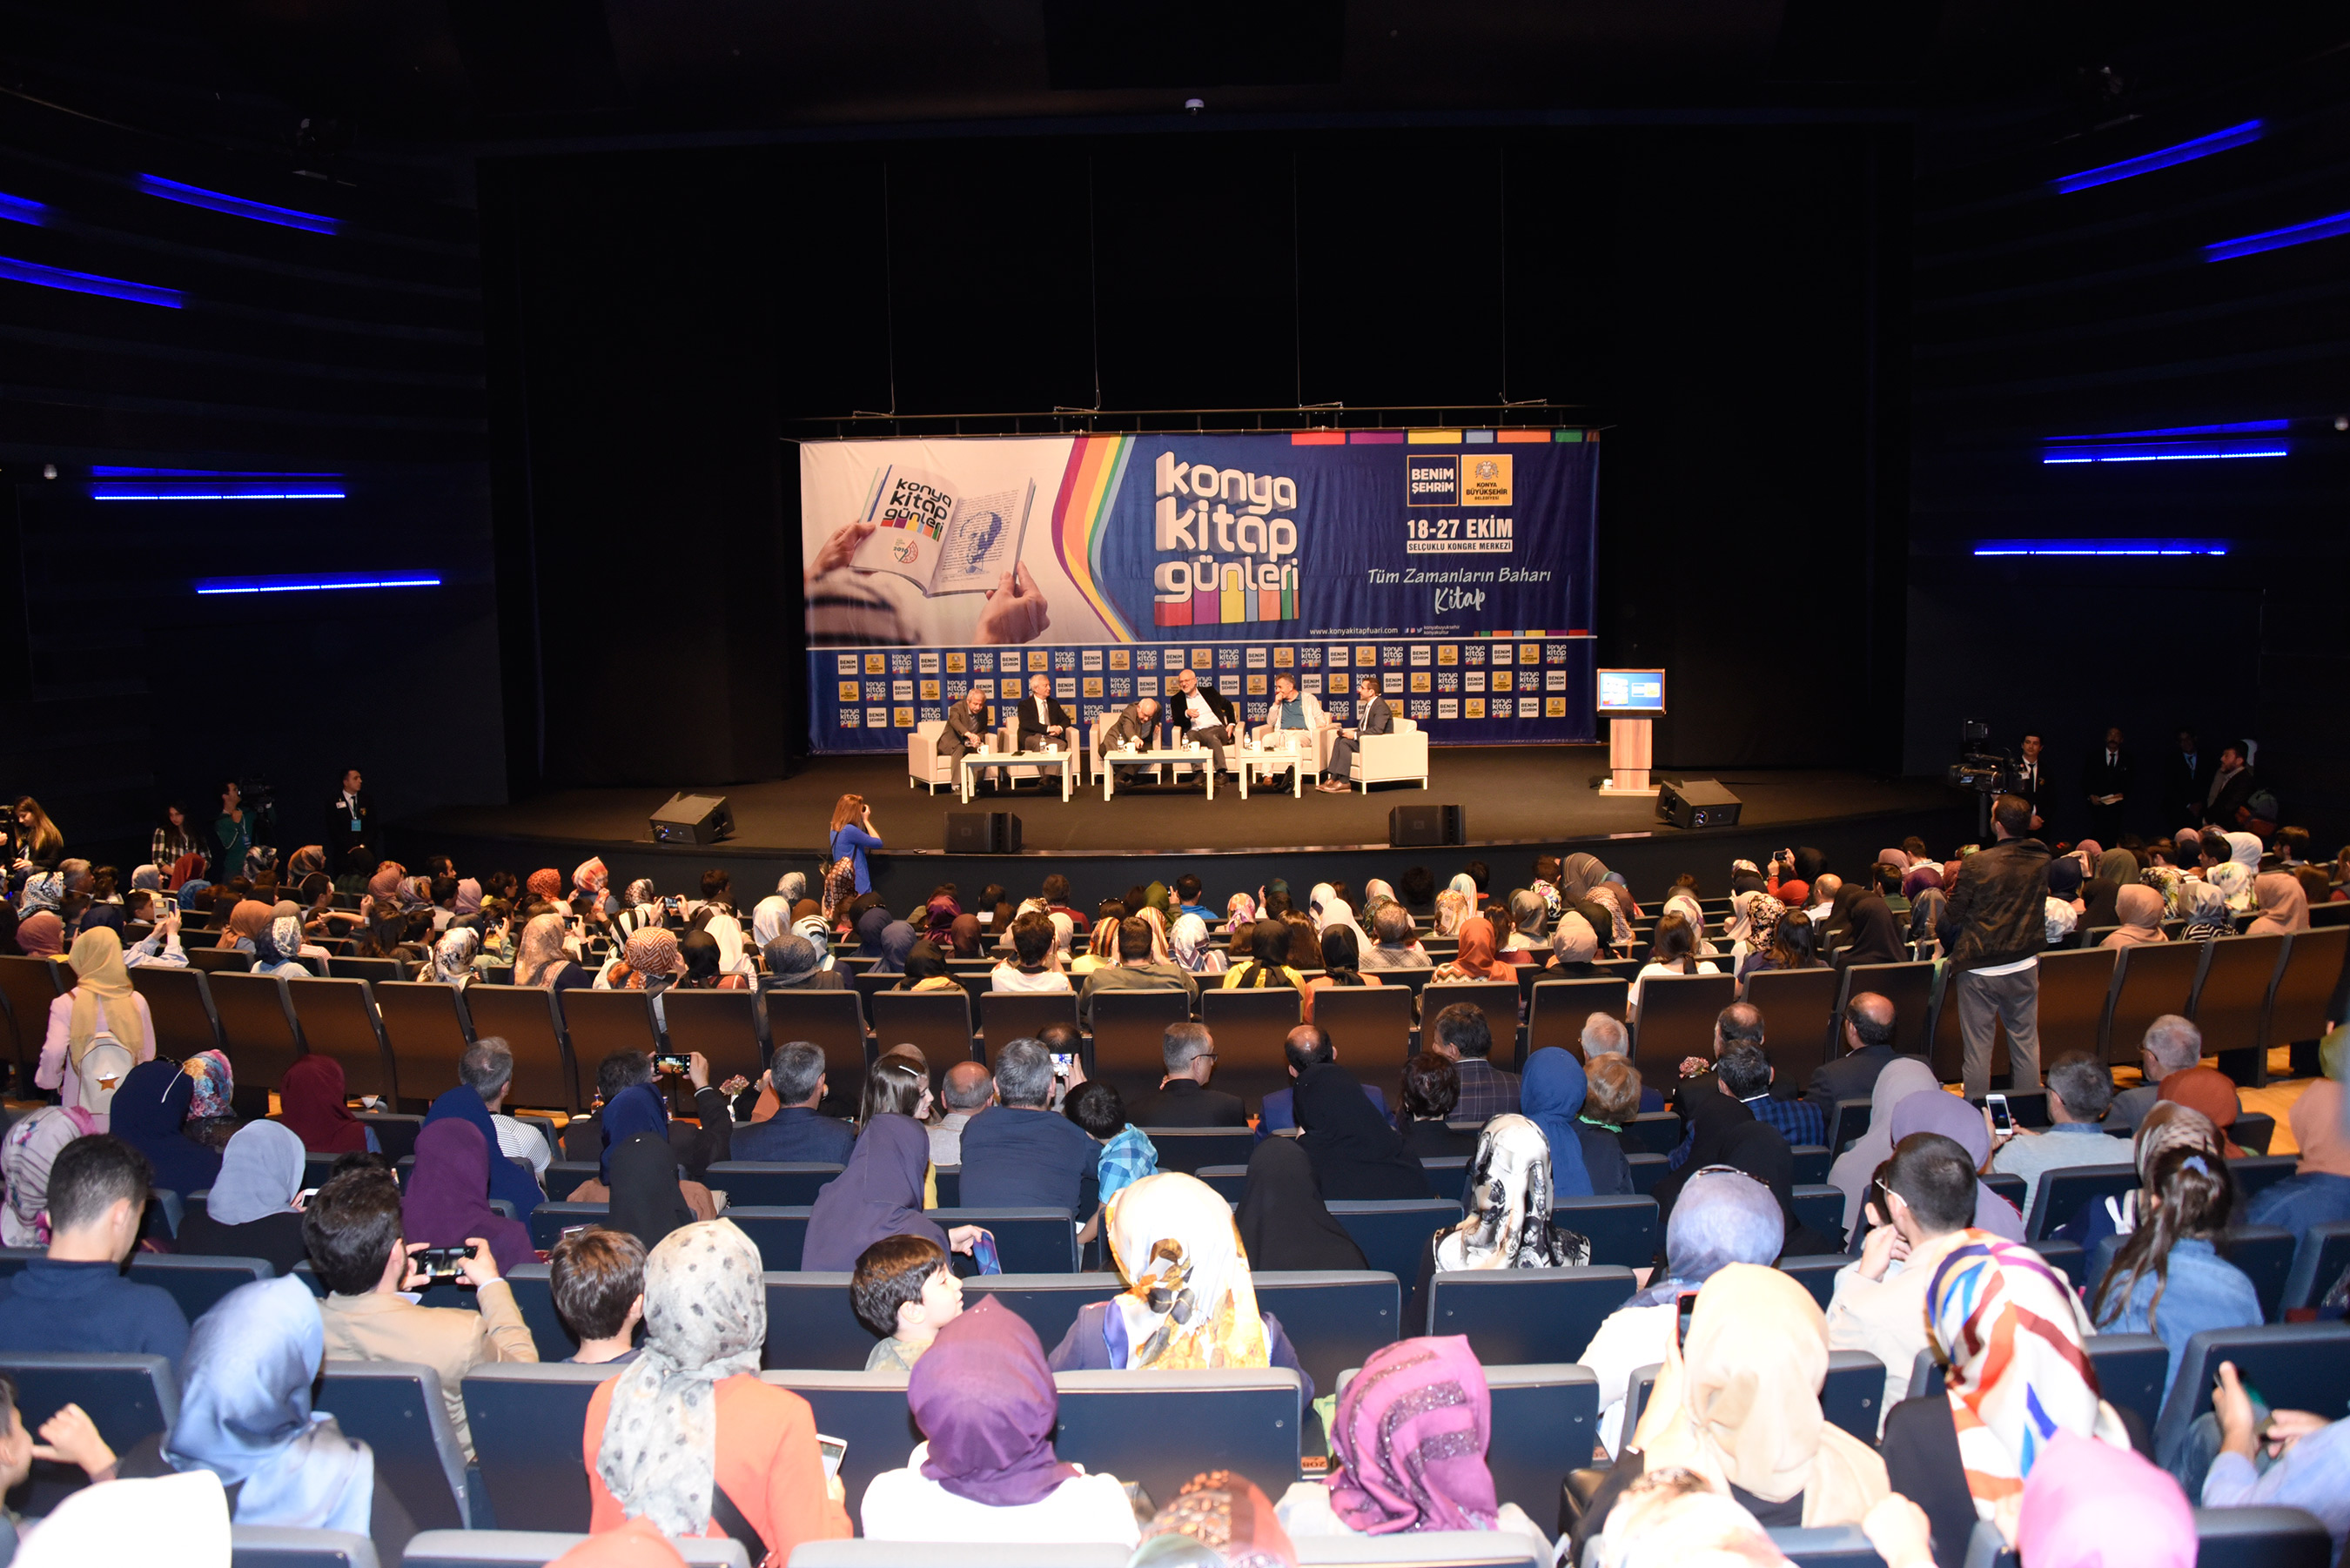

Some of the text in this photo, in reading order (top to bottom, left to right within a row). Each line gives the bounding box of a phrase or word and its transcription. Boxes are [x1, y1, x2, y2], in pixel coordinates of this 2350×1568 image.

[896, 478, 952, 508] konya
[1156, 451, 1297, 515] konya
[890, 491, 948, 520] kitap
[883, 507, 944, 533] günleri
[1156, 496, 1298, 562] kitap
[1407, 514, 1513, 539] 18-27 EKİM
[1479, 541, 1511, 550] MERKEZİ
[1155, 554, 1298, 603] günleri
[1367, 566, 1551, 584] Tüm Zamanların Baharı
[1434, 586, 1486, 614] Kitap
[1309, 627, 1399, 636] www.konyakitapfuari.com
